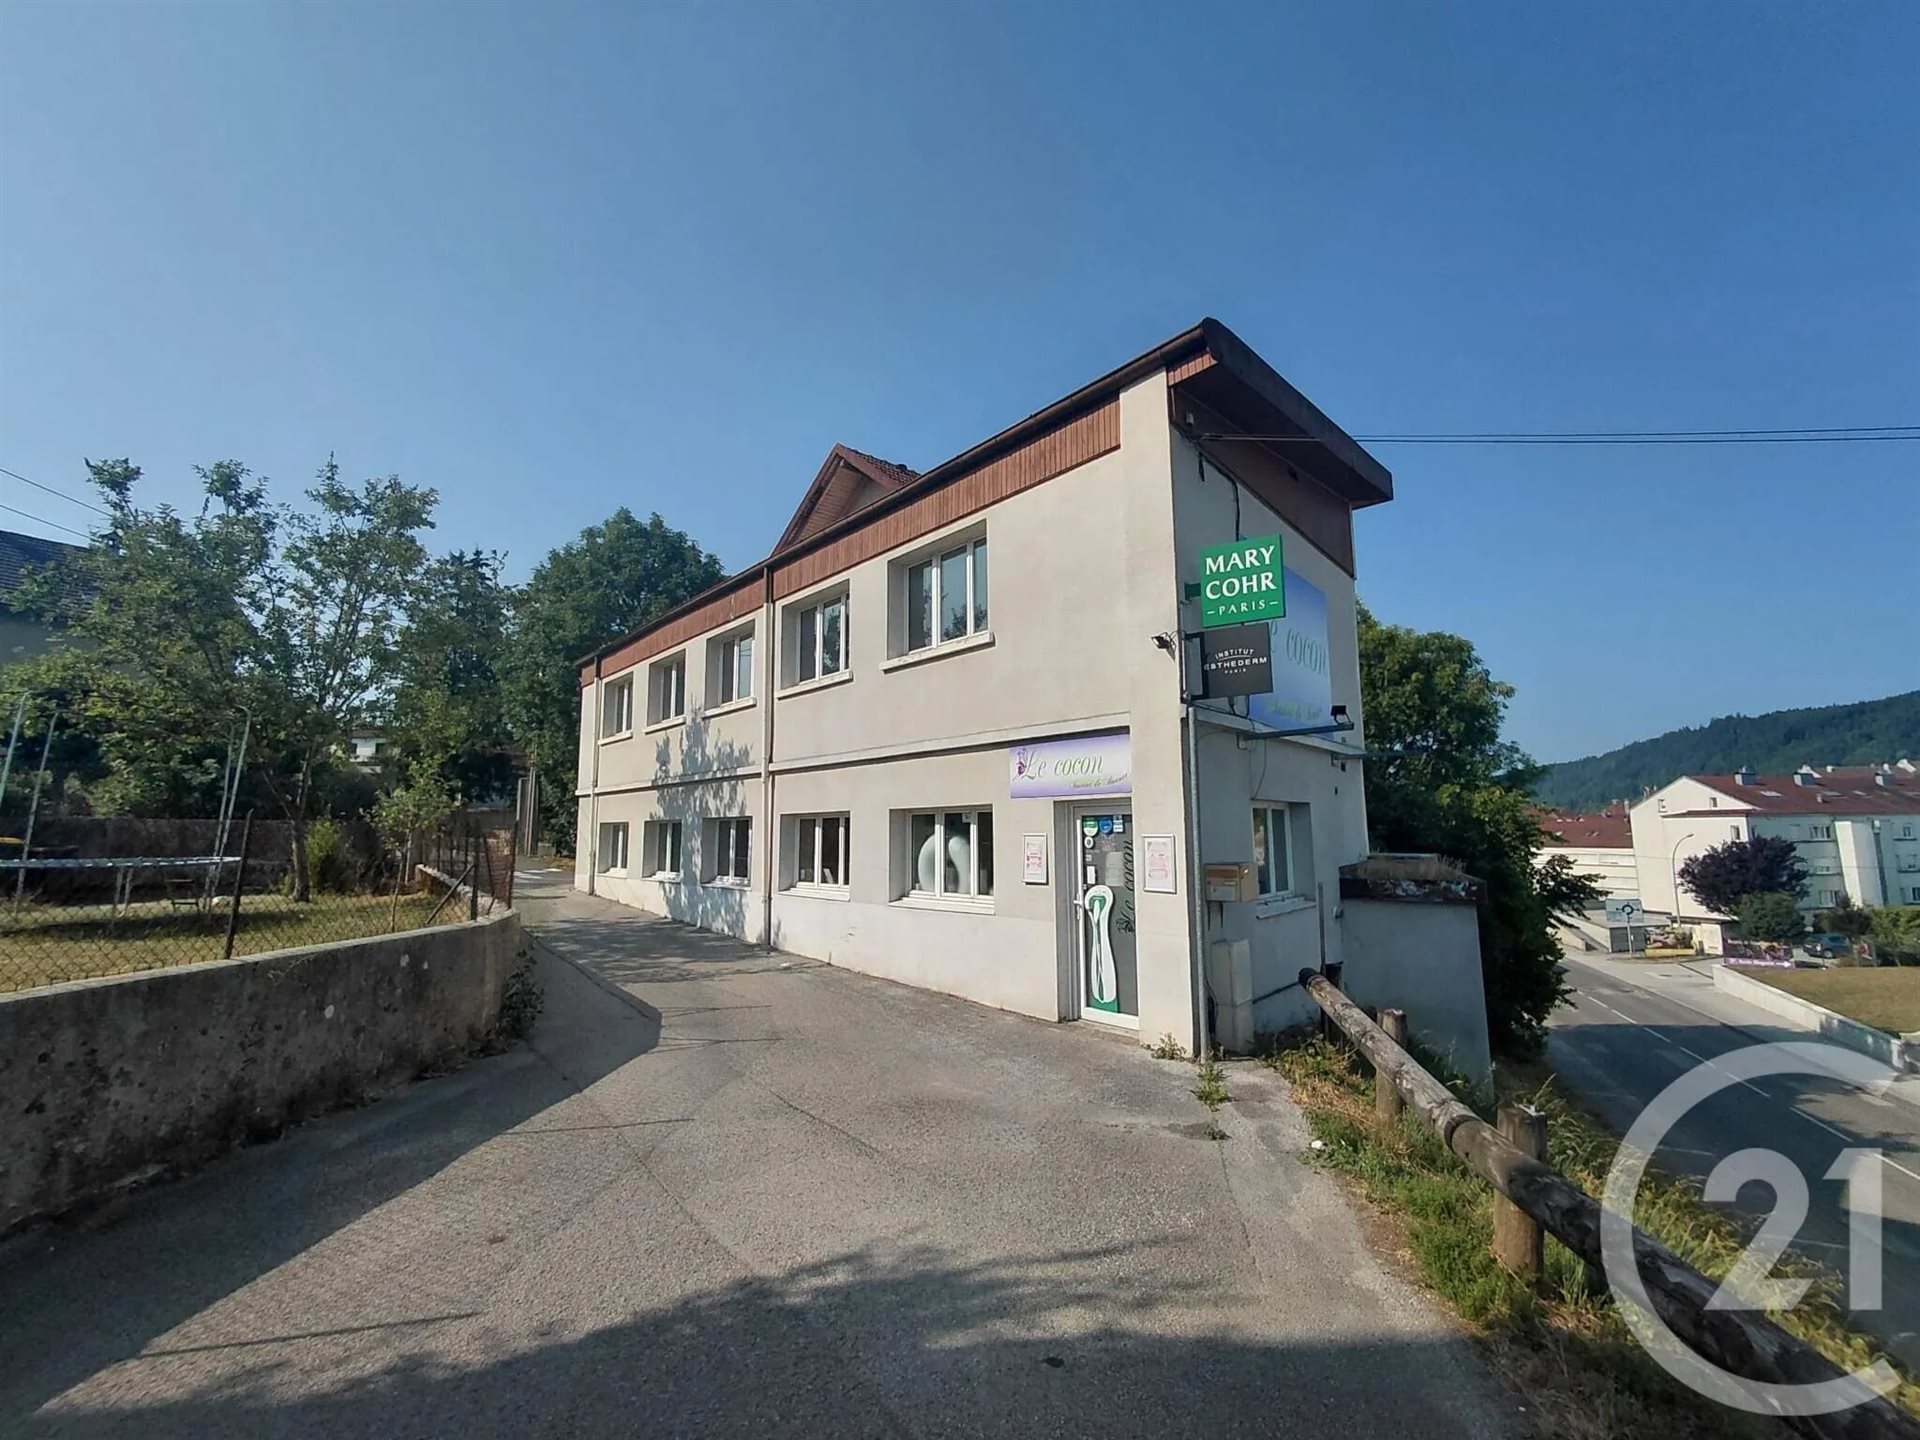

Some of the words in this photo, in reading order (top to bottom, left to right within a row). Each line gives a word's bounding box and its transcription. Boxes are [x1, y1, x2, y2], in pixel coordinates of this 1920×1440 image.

[1205, 545, 1275, 576] MARY
[1205, 571, 1277, 600] COHR
[1218, 599, 1266, 616] PARIS
[1214, 647, 1255, 660] INSTITUT
[1020, 748, 1047, 781] Le
[1054, 755, 1103, 777] cocon
